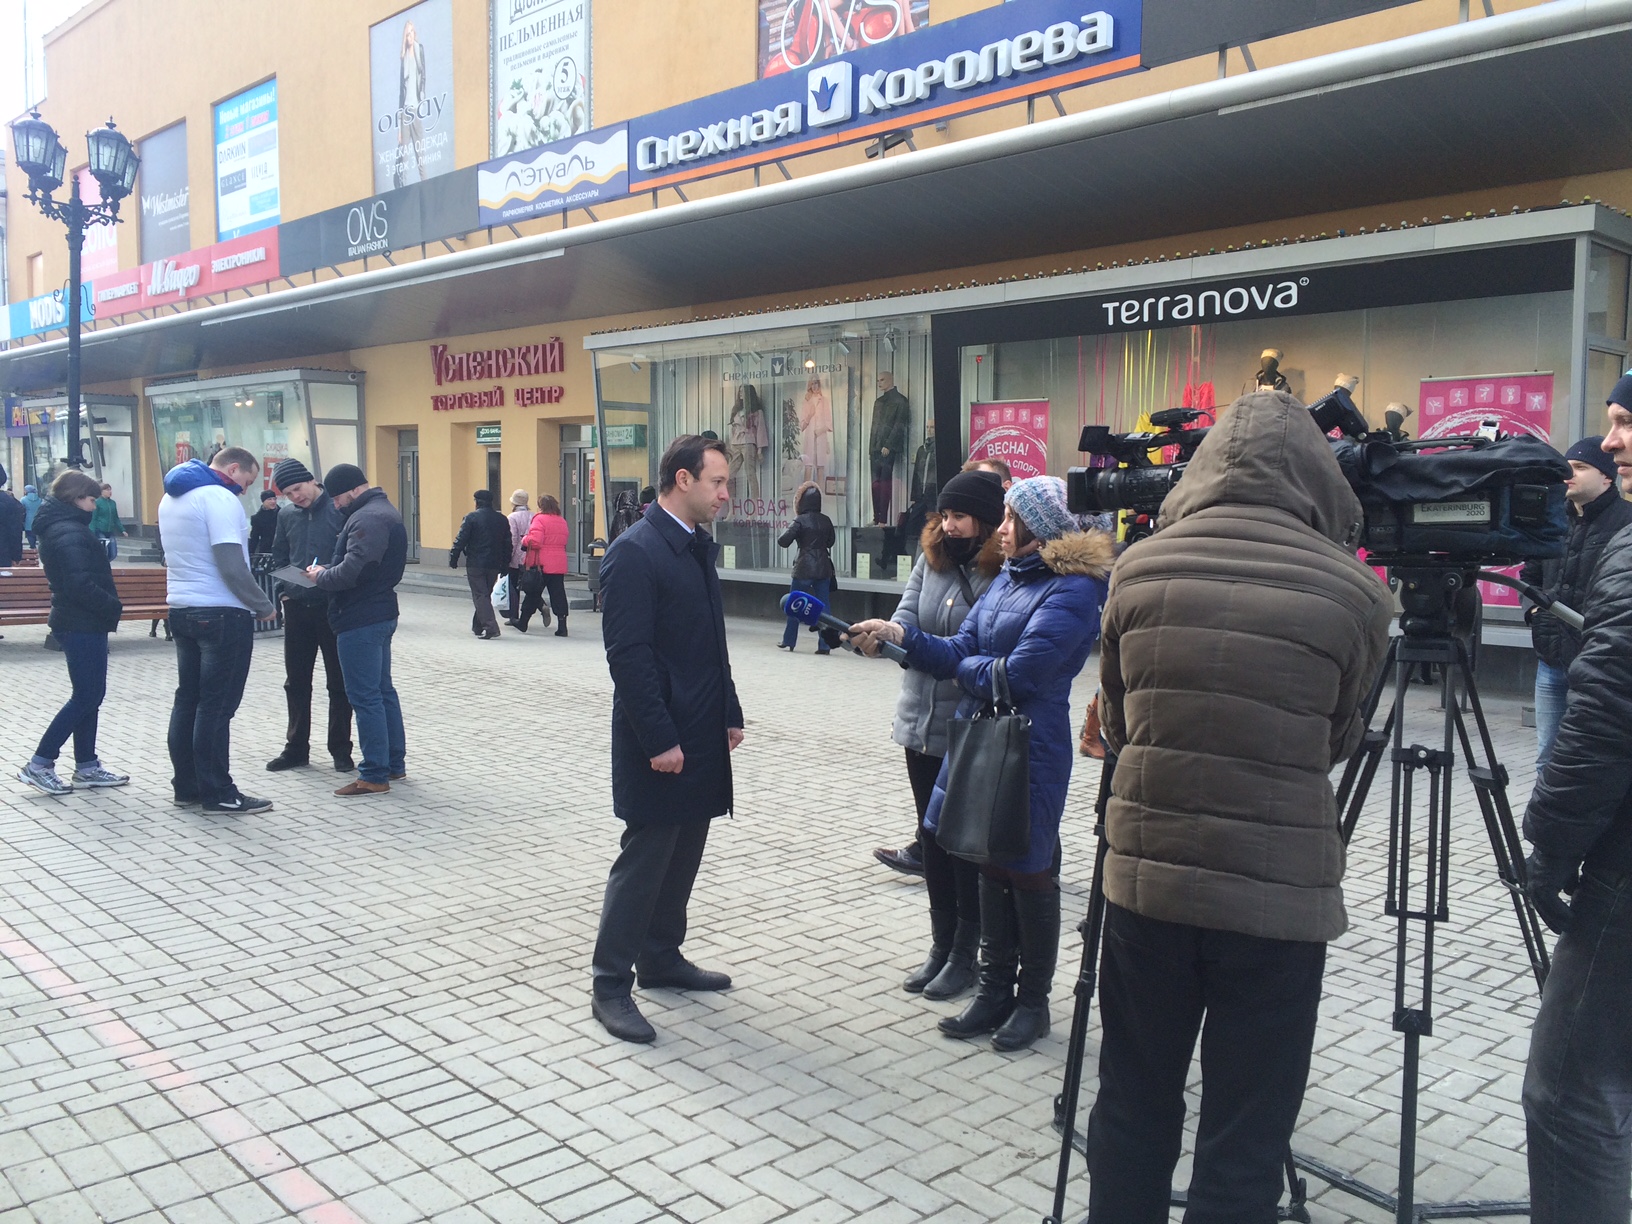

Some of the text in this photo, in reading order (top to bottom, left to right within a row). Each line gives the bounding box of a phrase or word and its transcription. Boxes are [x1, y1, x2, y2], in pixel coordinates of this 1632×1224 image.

[499, 3, 583, 52] ПЕЛЬМЕННАЯ
[503, 44, 543, 66] традиционные
[510, 55, 537, 71] пельмени
[542, 43, 570, 60] вареники
[560, 61, 569, 83] 5
[377, 92, 447, 133] orsay
[378, 131, 449, 165] ЖЕНСКАЯ ОДЕЖДА
[636, 100, 801, 171] Снежная
[385, 150, 442, 177] 3 этаж 3 линия
[502, 188, 600, 218] ПАРФЮМЕРИЯ КОСМЕТИКА АКСЕССУАРЫ
[347, 200, 388, 245] OVS
[348, 238, 389, 257] ITALIAN FASHION
[723, 369, 769, 381] Снежная
[431, 385, 565, 411] ТОРГОВЫЙ ЦЕНТР
[625, 428, 633, 439] 24
[987, 440, 1029, 457] ВЕСНА!
[732, 498, 787, 516] НОВАЯ
[1421, 503, 1485, 513] EKATERINBURG
